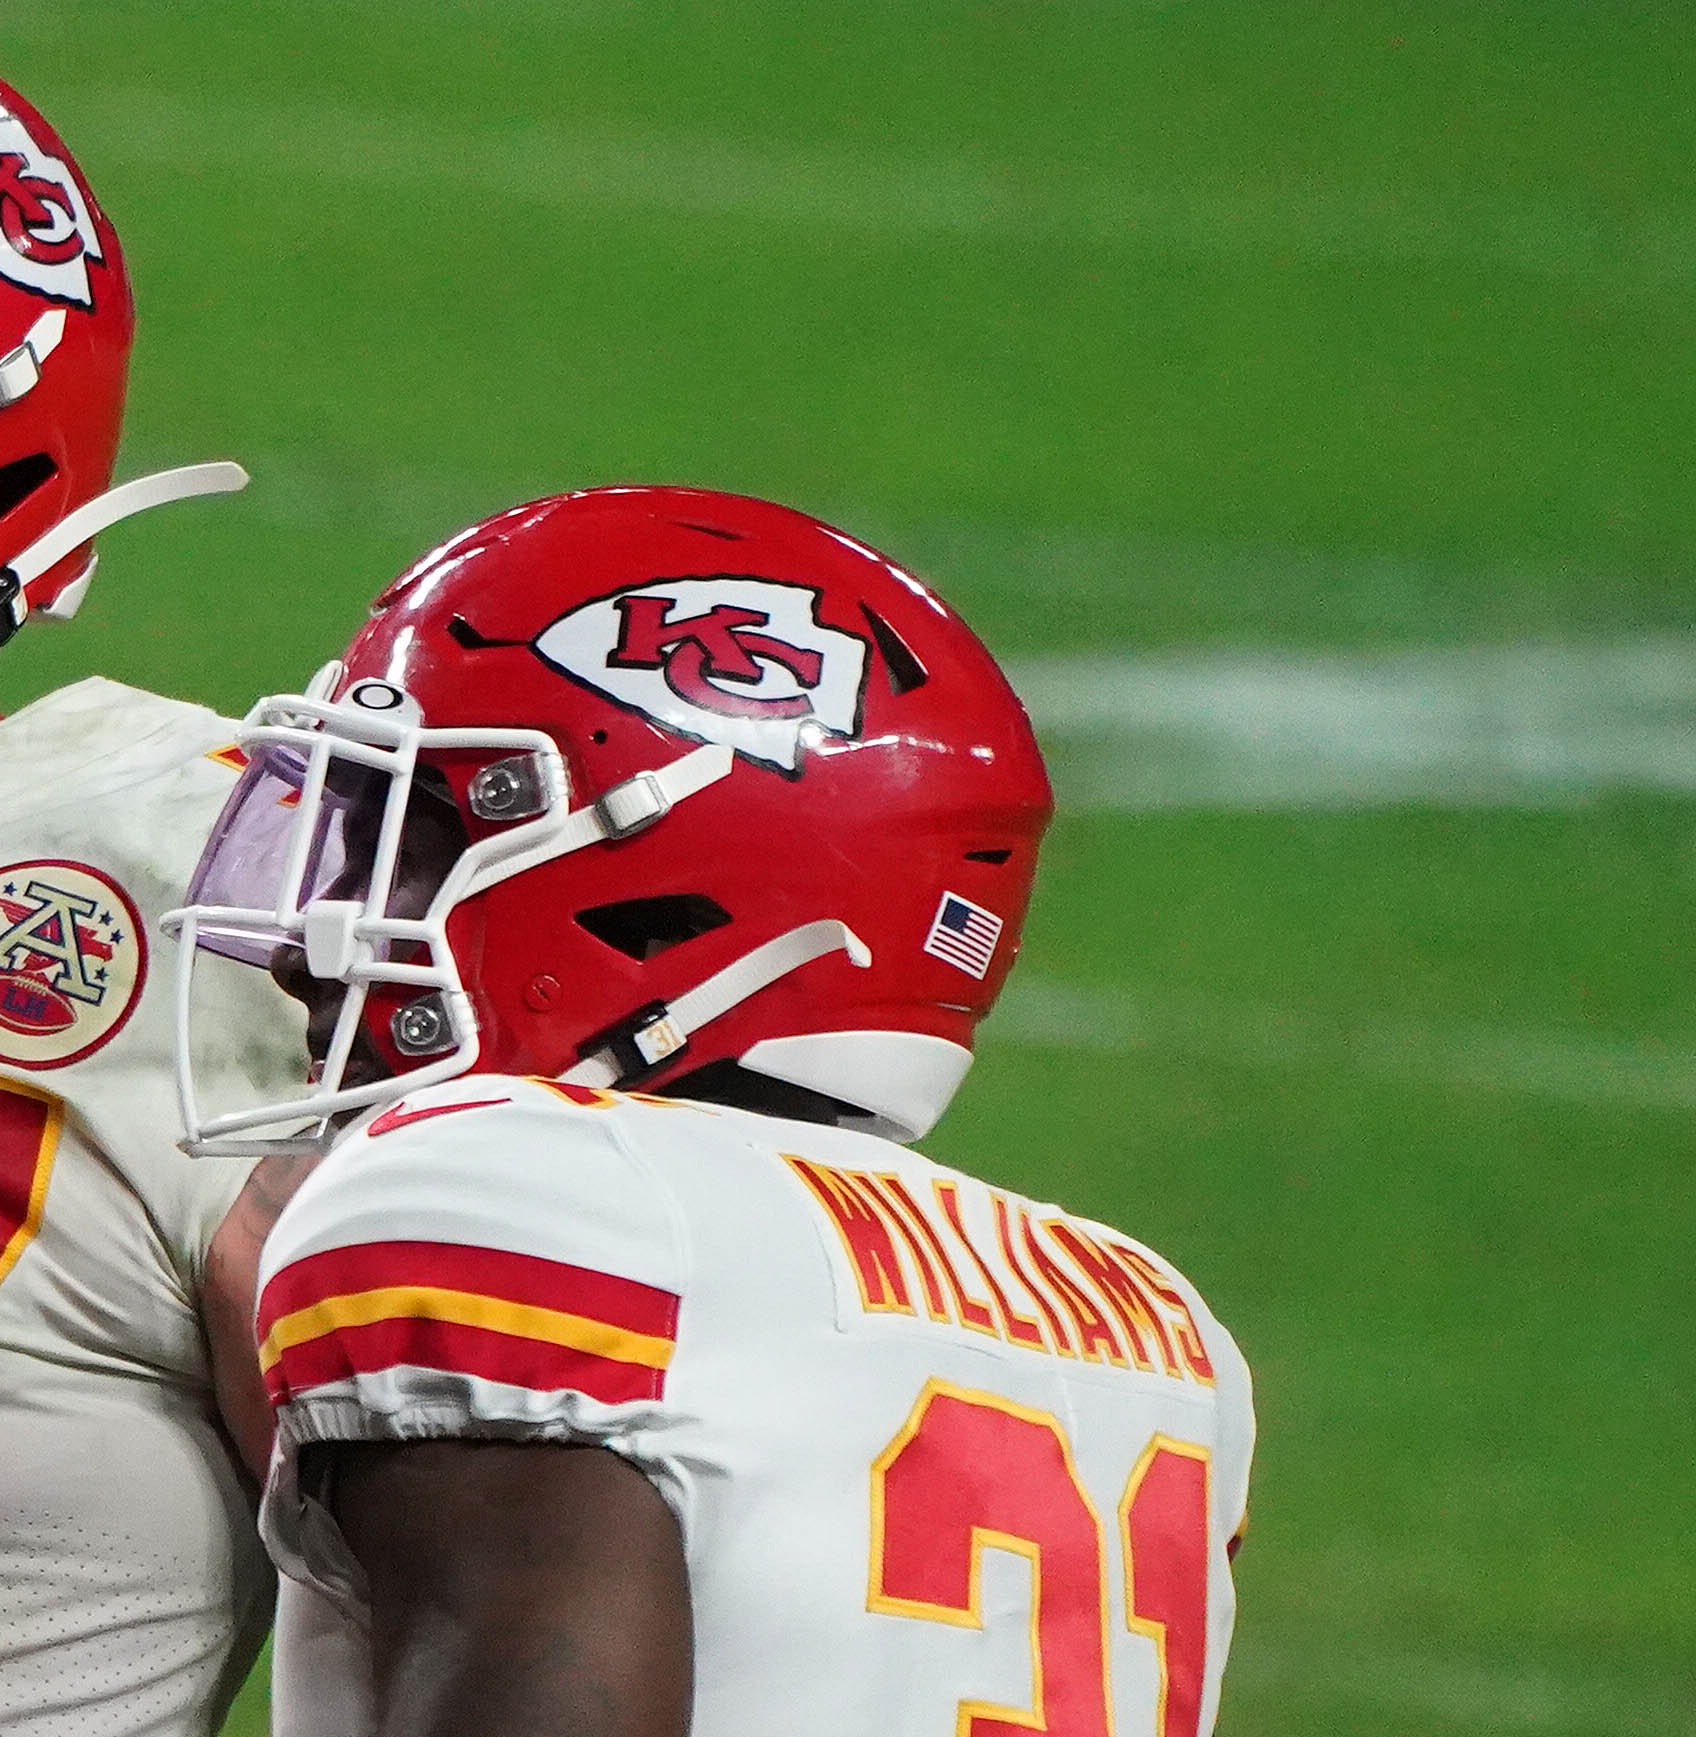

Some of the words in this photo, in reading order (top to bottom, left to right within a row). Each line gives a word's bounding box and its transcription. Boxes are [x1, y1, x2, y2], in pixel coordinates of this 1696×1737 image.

[606, 595, 824, 720] KC
[1, 986, 48, 1020] LH
[779, 1152, 1216, 1387] WILLIAMS
